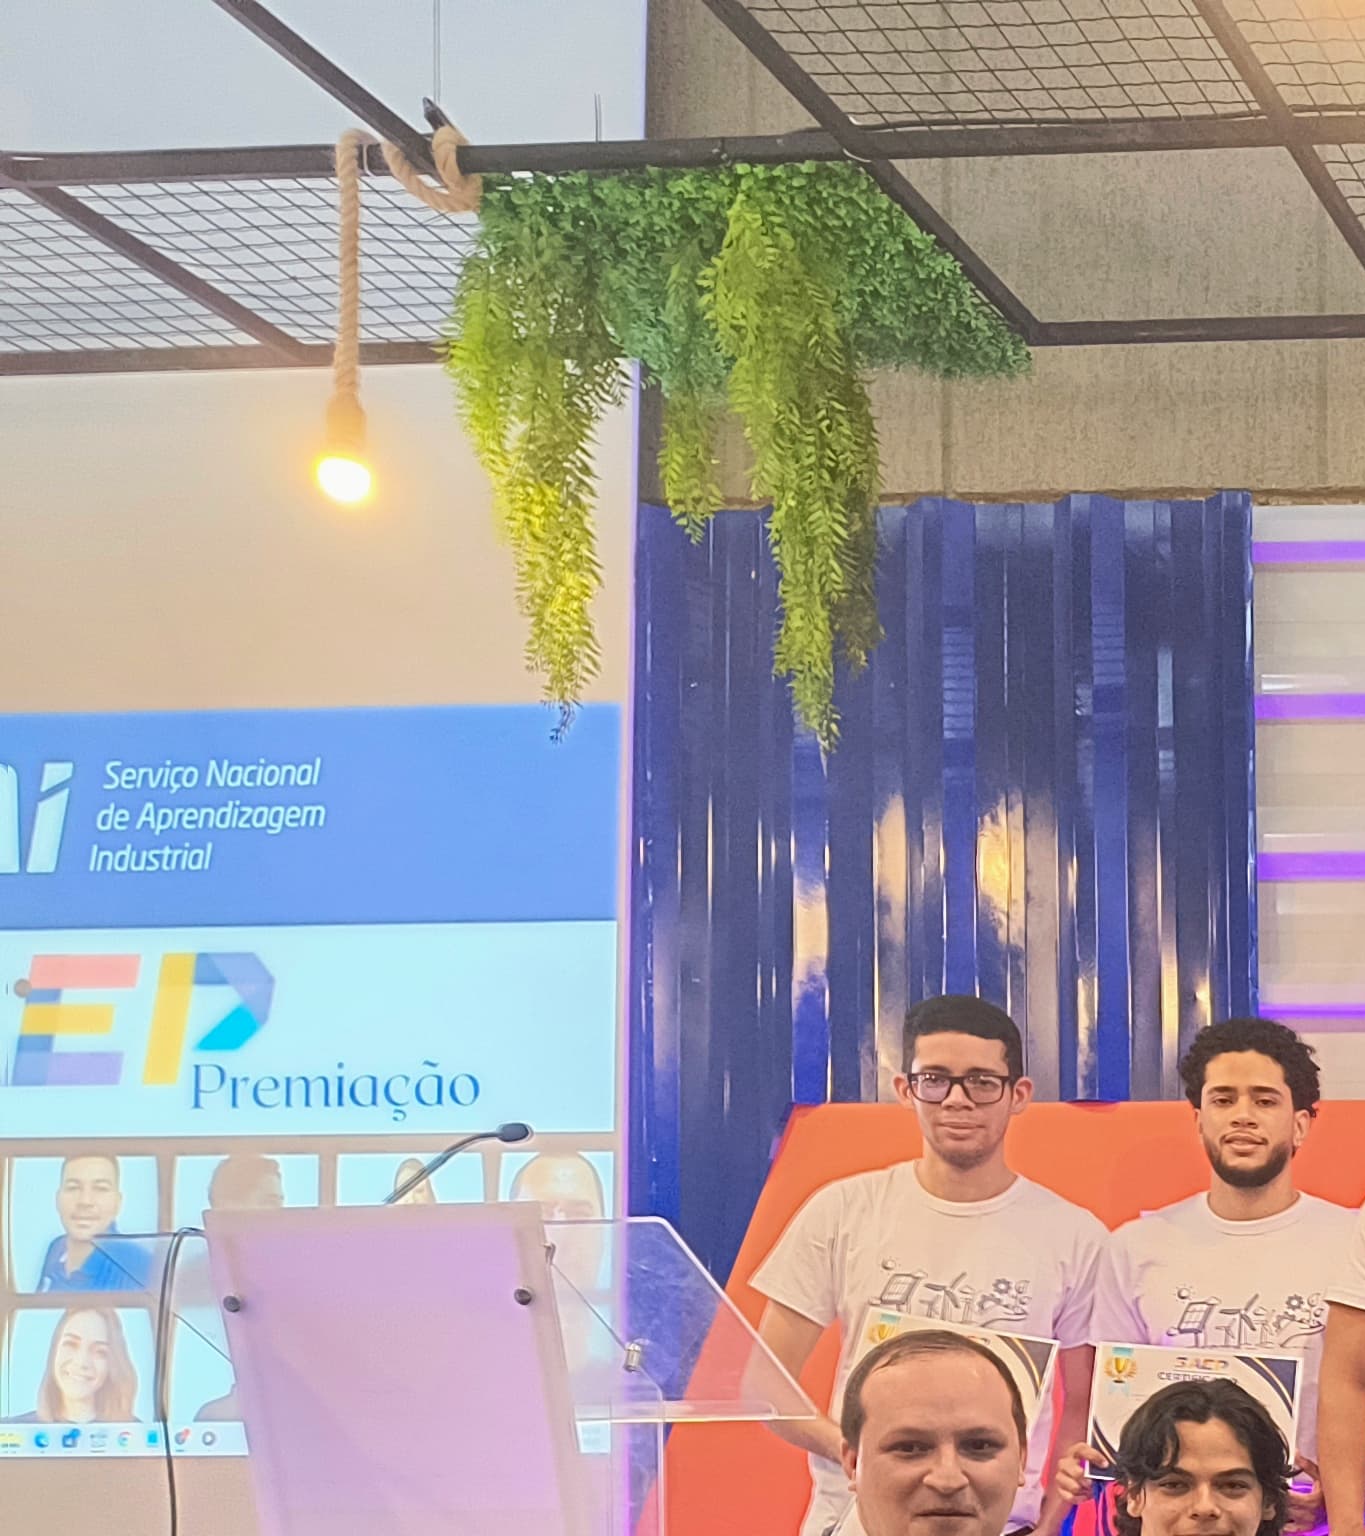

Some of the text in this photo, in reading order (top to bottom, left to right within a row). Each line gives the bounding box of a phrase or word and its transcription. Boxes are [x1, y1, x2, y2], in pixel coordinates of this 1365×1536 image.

[103, 758, 321, 793] Serviço Nacional
[97, 800, 326, 835] de Aprendizagem
[90, 842, 212, 872] Industrial
[191, 1060, 480, 1121] Premiação
